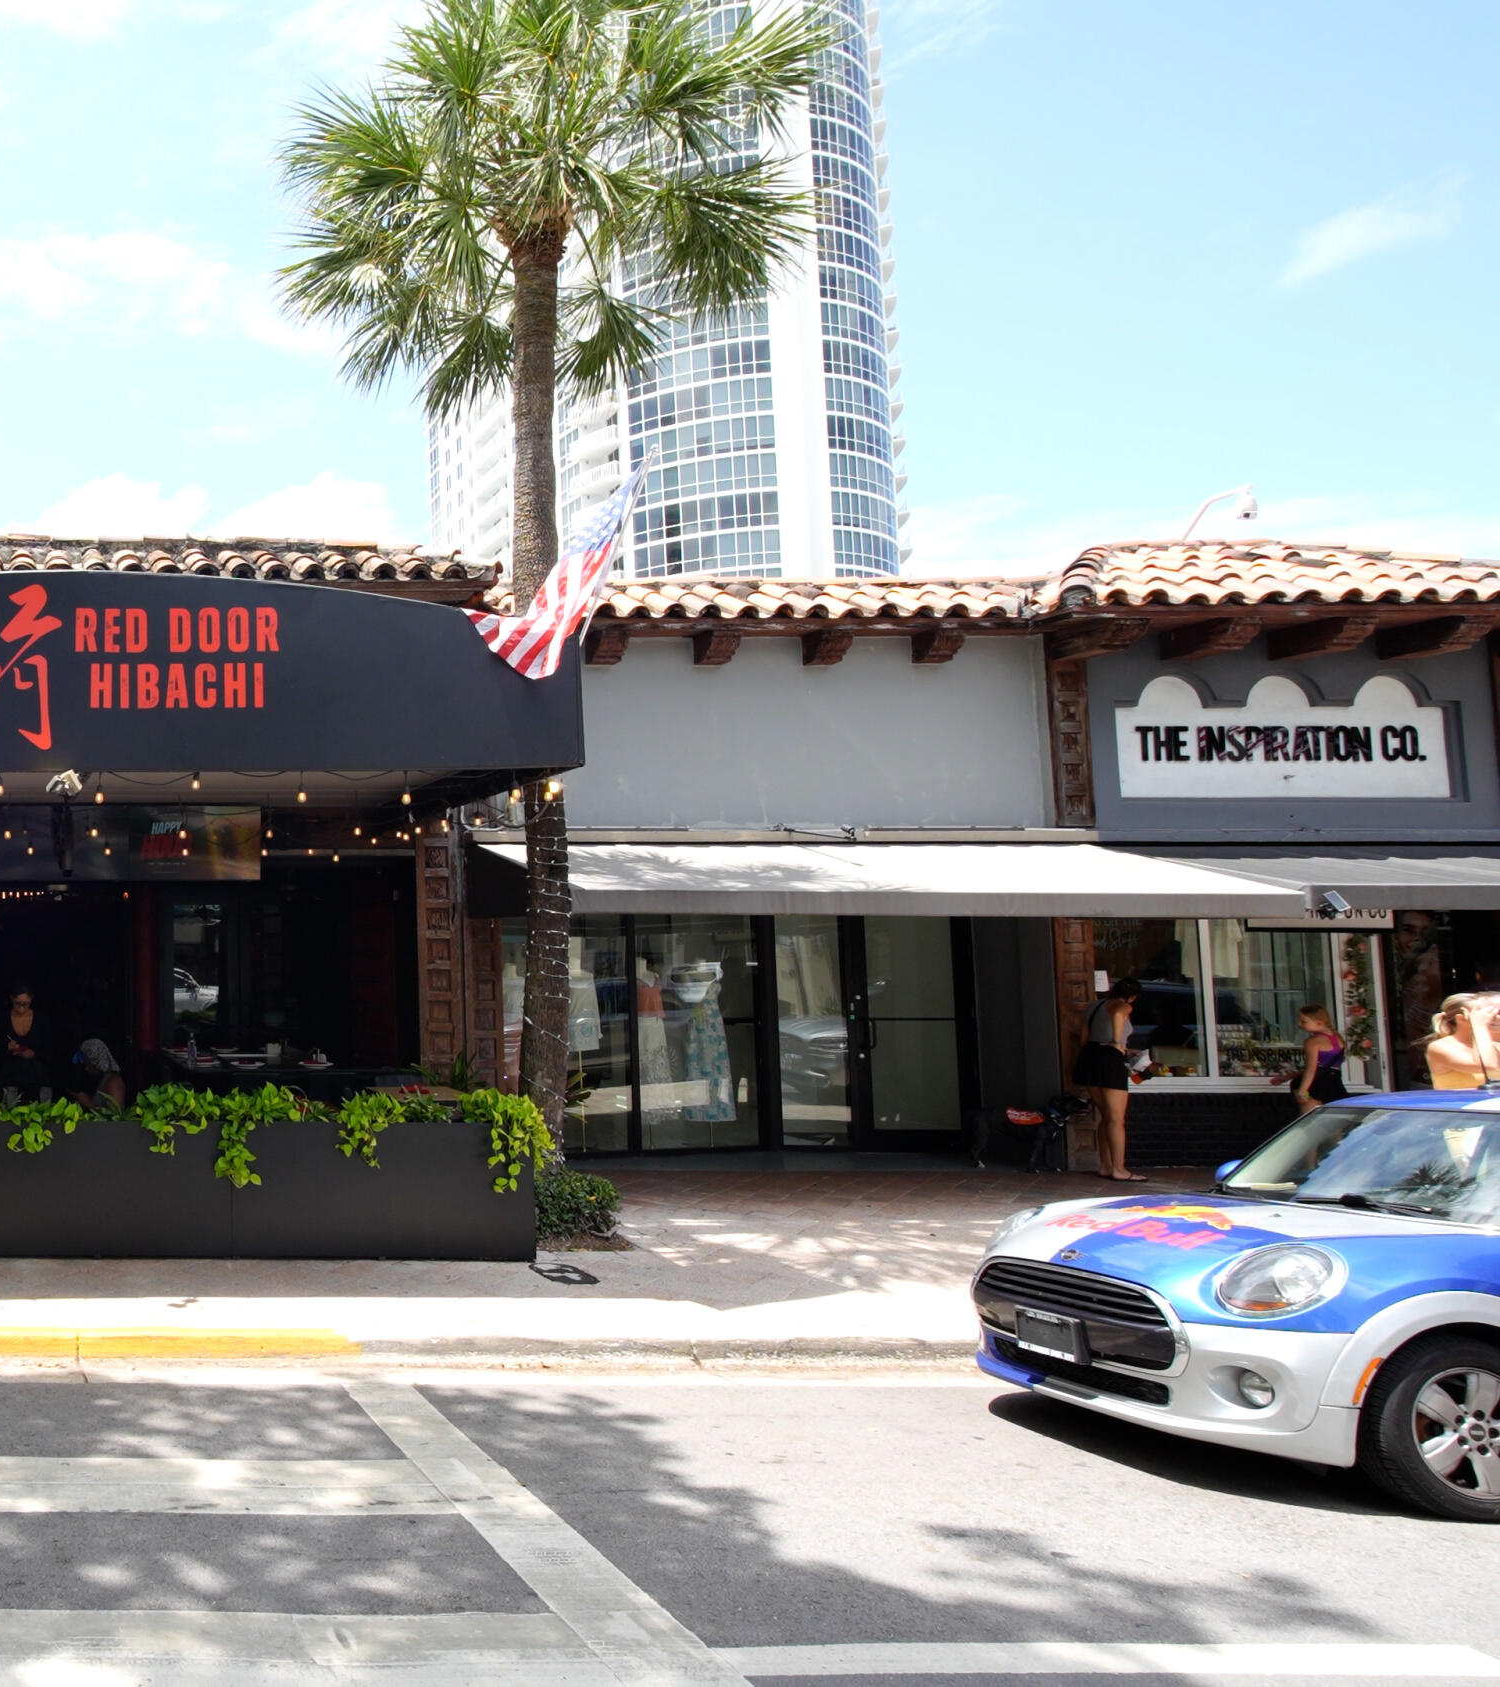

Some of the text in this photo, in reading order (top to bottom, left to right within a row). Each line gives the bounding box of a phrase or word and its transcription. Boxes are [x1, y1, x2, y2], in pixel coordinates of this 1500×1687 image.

[75, 606, 279, 653] RED DOOR
[90, 662, 264, 709] HIBACHI
[1135, 724, 1427, 762] THE INSPIRATION CO.
[150, 821, 182, 835] HAPPY
[1045, 1214, 1226, 1250] Red Bull
